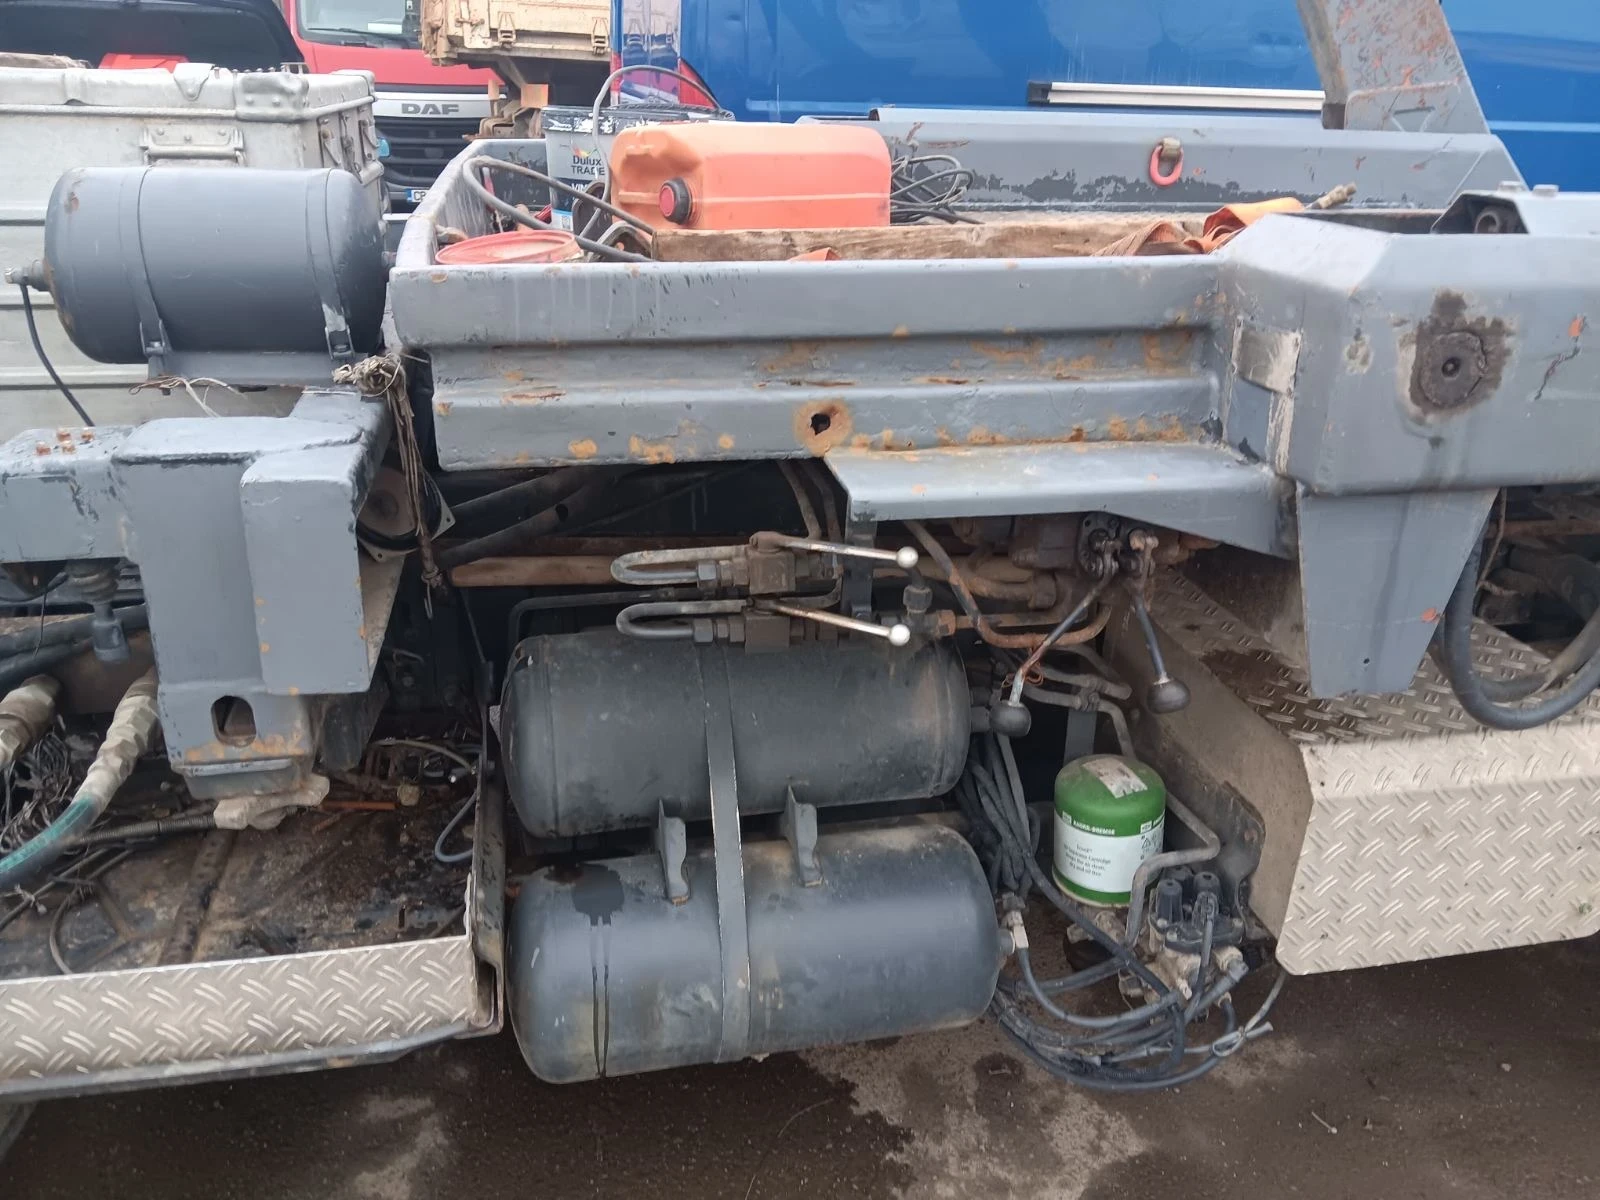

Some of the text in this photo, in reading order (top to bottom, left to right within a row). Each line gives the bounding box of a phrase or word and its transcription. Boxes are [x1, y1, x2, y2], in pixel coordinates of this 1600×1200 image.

[401, 103, 460, 115] DAF
[573, 155, 602, 166] Dulux
[571, 165, 606, 176] TRADE
